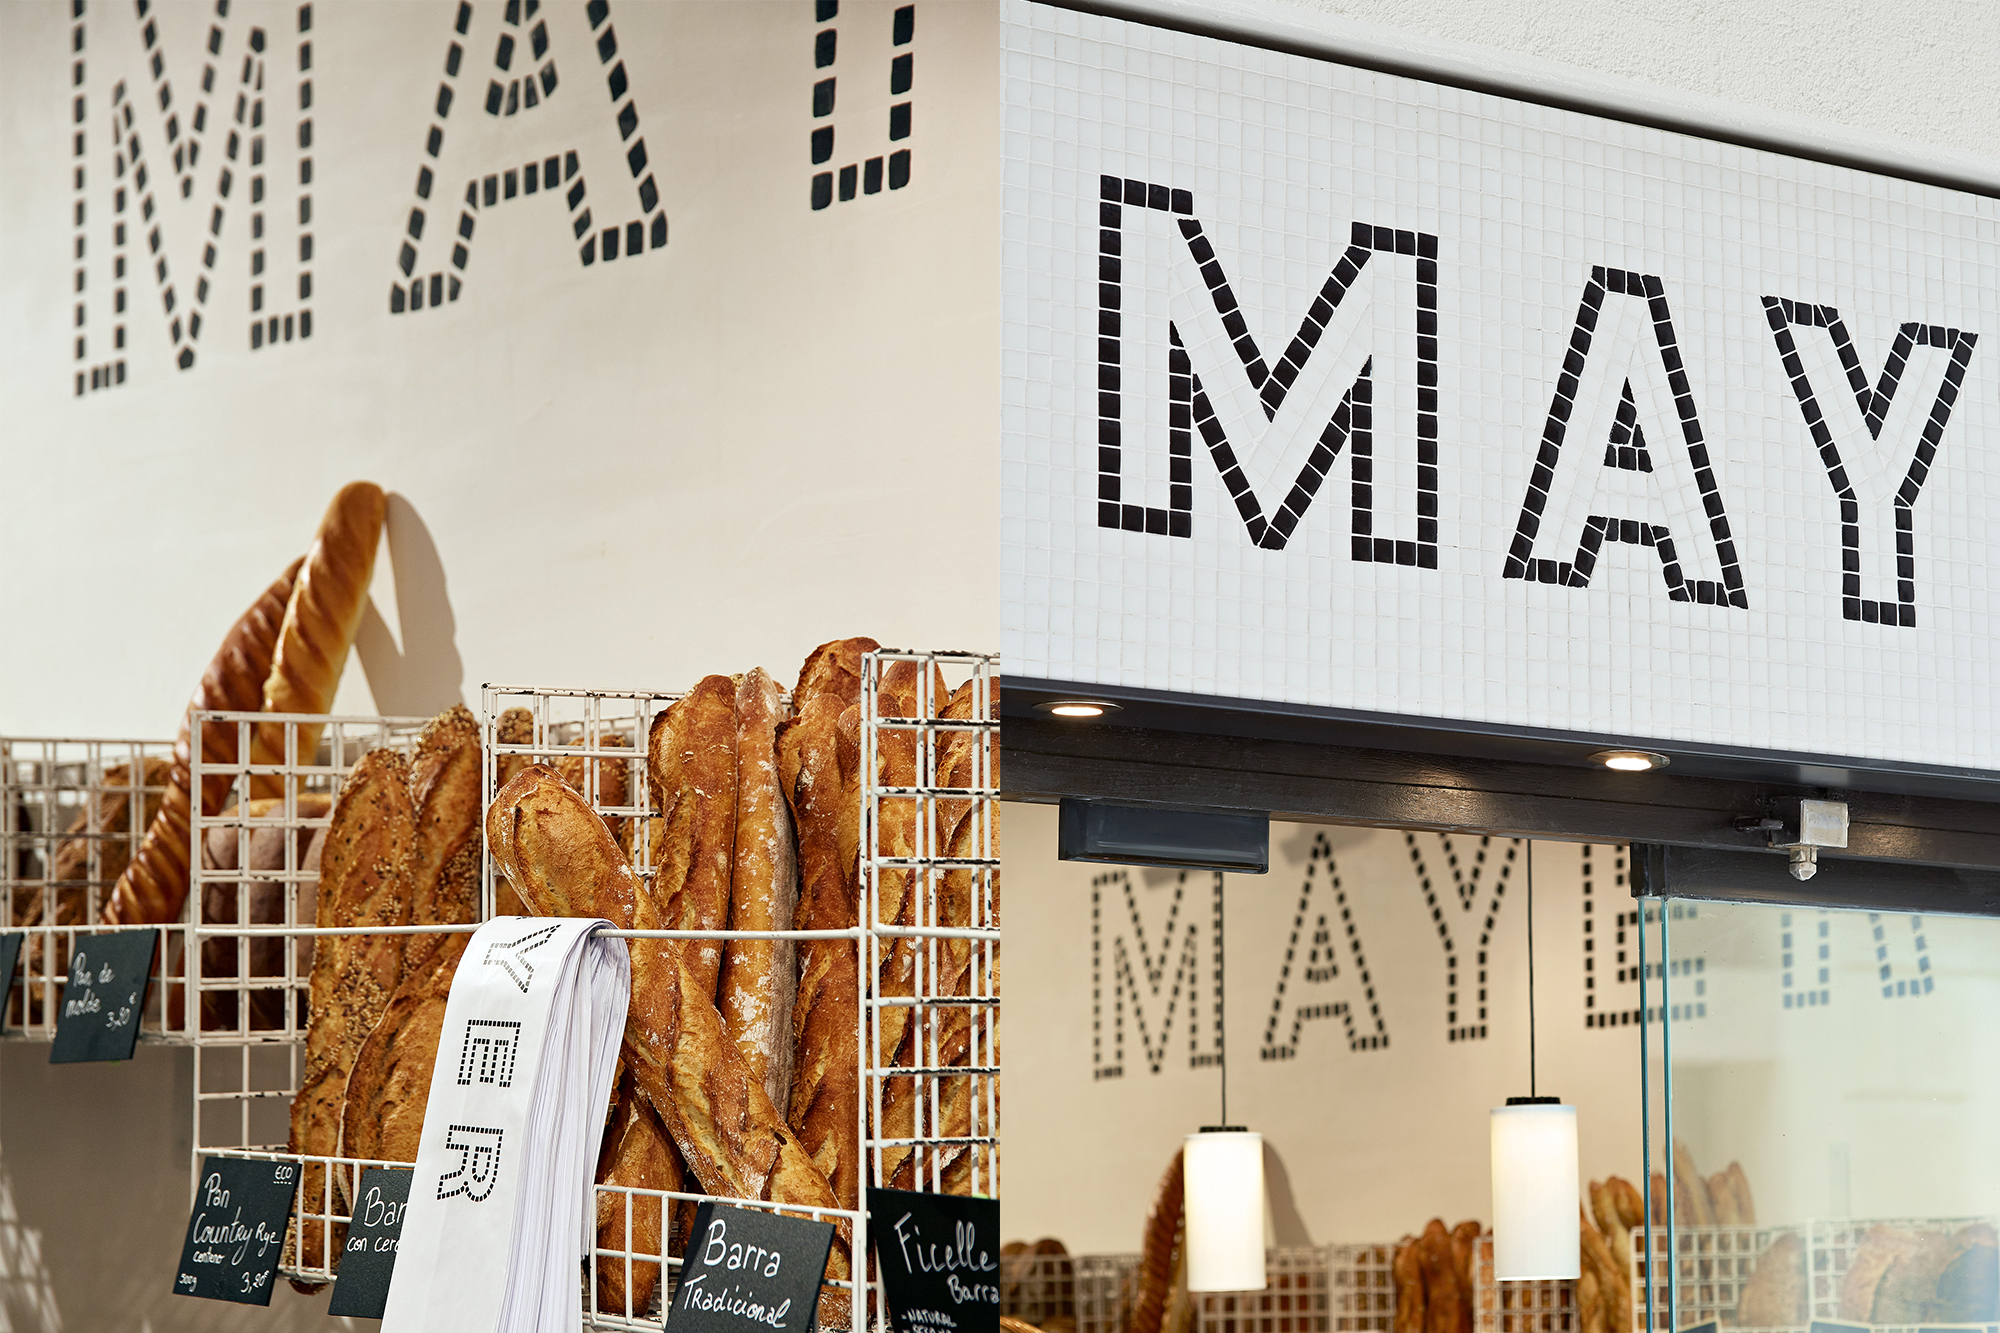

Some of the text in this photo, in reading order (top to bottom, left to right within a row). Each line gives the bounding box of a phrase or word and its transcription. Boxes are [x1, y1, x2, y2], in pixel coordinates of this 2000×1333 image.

[1098, 173, 1979, 628] MAY
[98, 961, 115, 984] de
[204, 1172, 231, 1209] Pan
[255, 1221, 281, 1258] Rye
[346, 1236, 368, 1252] con
[703, 1218, 781, 1278] Barra
[893, 1211, 998, 1274] Ficelle
[946, 1273, 1000, 1305] Barra
